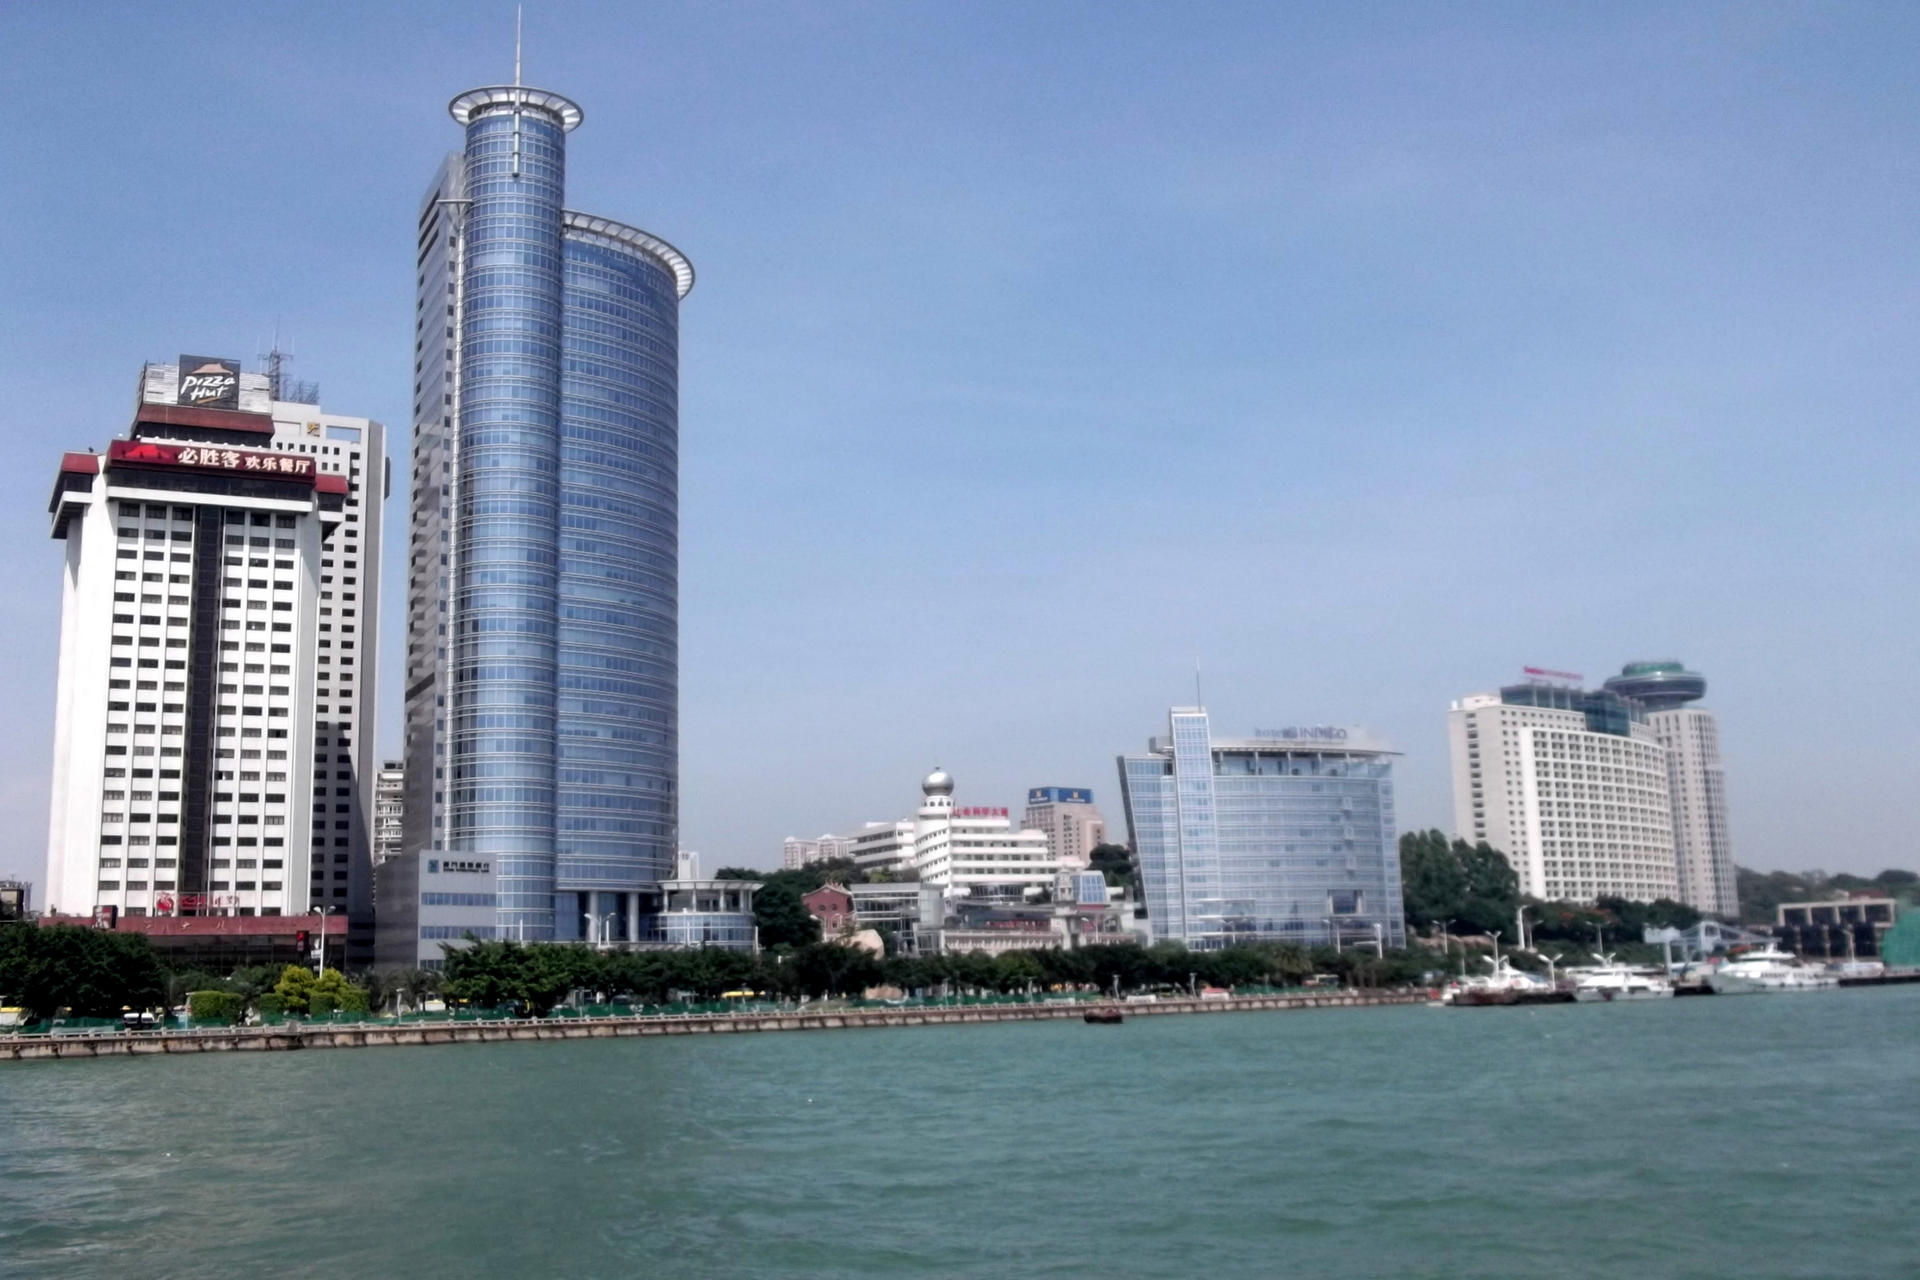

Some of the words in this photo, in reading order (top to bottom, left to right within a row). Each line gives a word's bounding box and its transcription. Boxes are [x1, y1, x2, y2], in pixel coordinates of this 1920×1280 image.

[180, 375, 236, 395] Pizza
[190, 386, 229, 401] Hut
[178, 447, 241, 468] 必胜客
[244, 456, 311, 474] 欢乐餐厅
